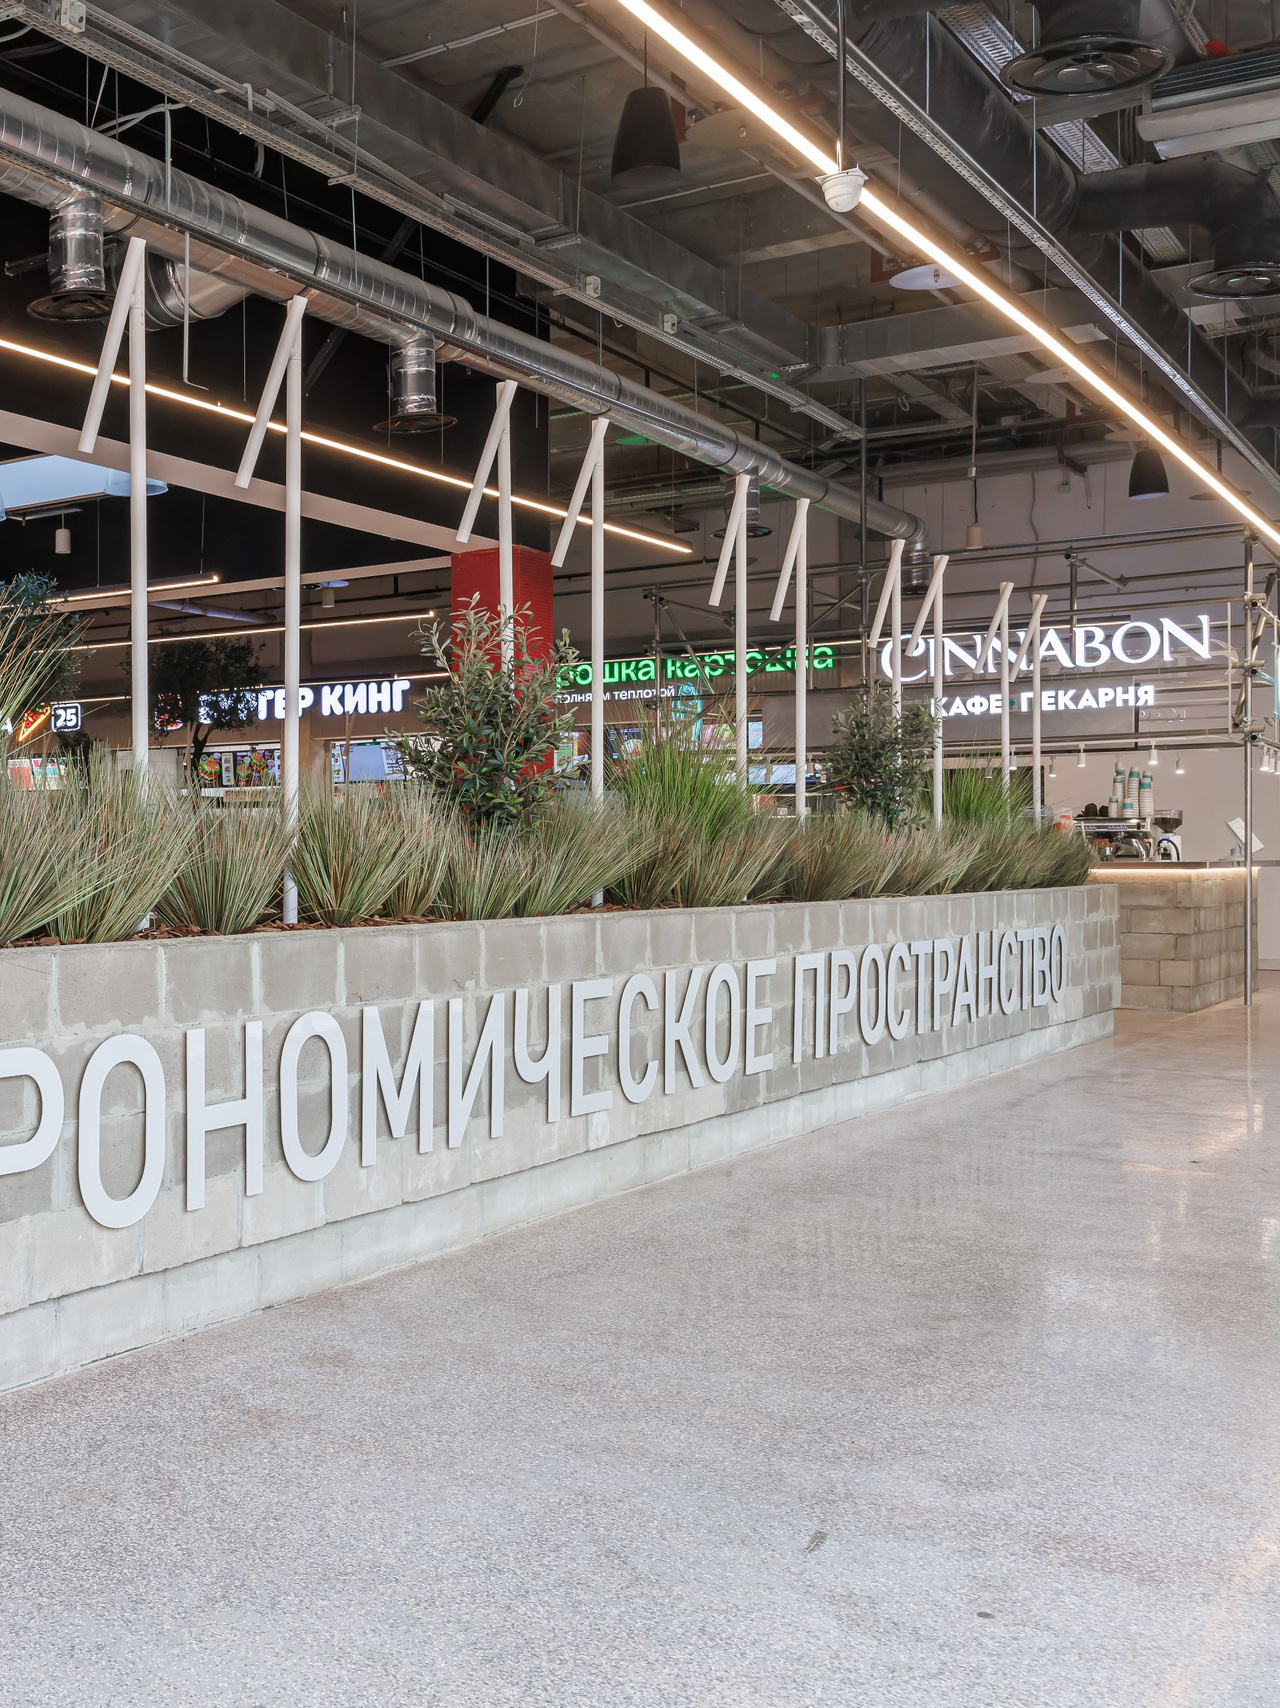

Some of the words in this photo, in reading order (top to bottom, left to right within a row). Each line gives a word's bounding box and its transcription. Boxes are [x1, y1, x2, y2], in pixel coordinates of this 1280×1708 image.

[879, 613, 1213, 683] CINNABON
[321, 679, 412, 717] КИНГ
[930, 693, 1003, 718] КАФЕ
[1020, 684, 1156, 713] ПЕКАРНЯ
[55, 708, 77, 727] 25
[791, 924, 1068, 1063] ПРОСТРАНСТВО
